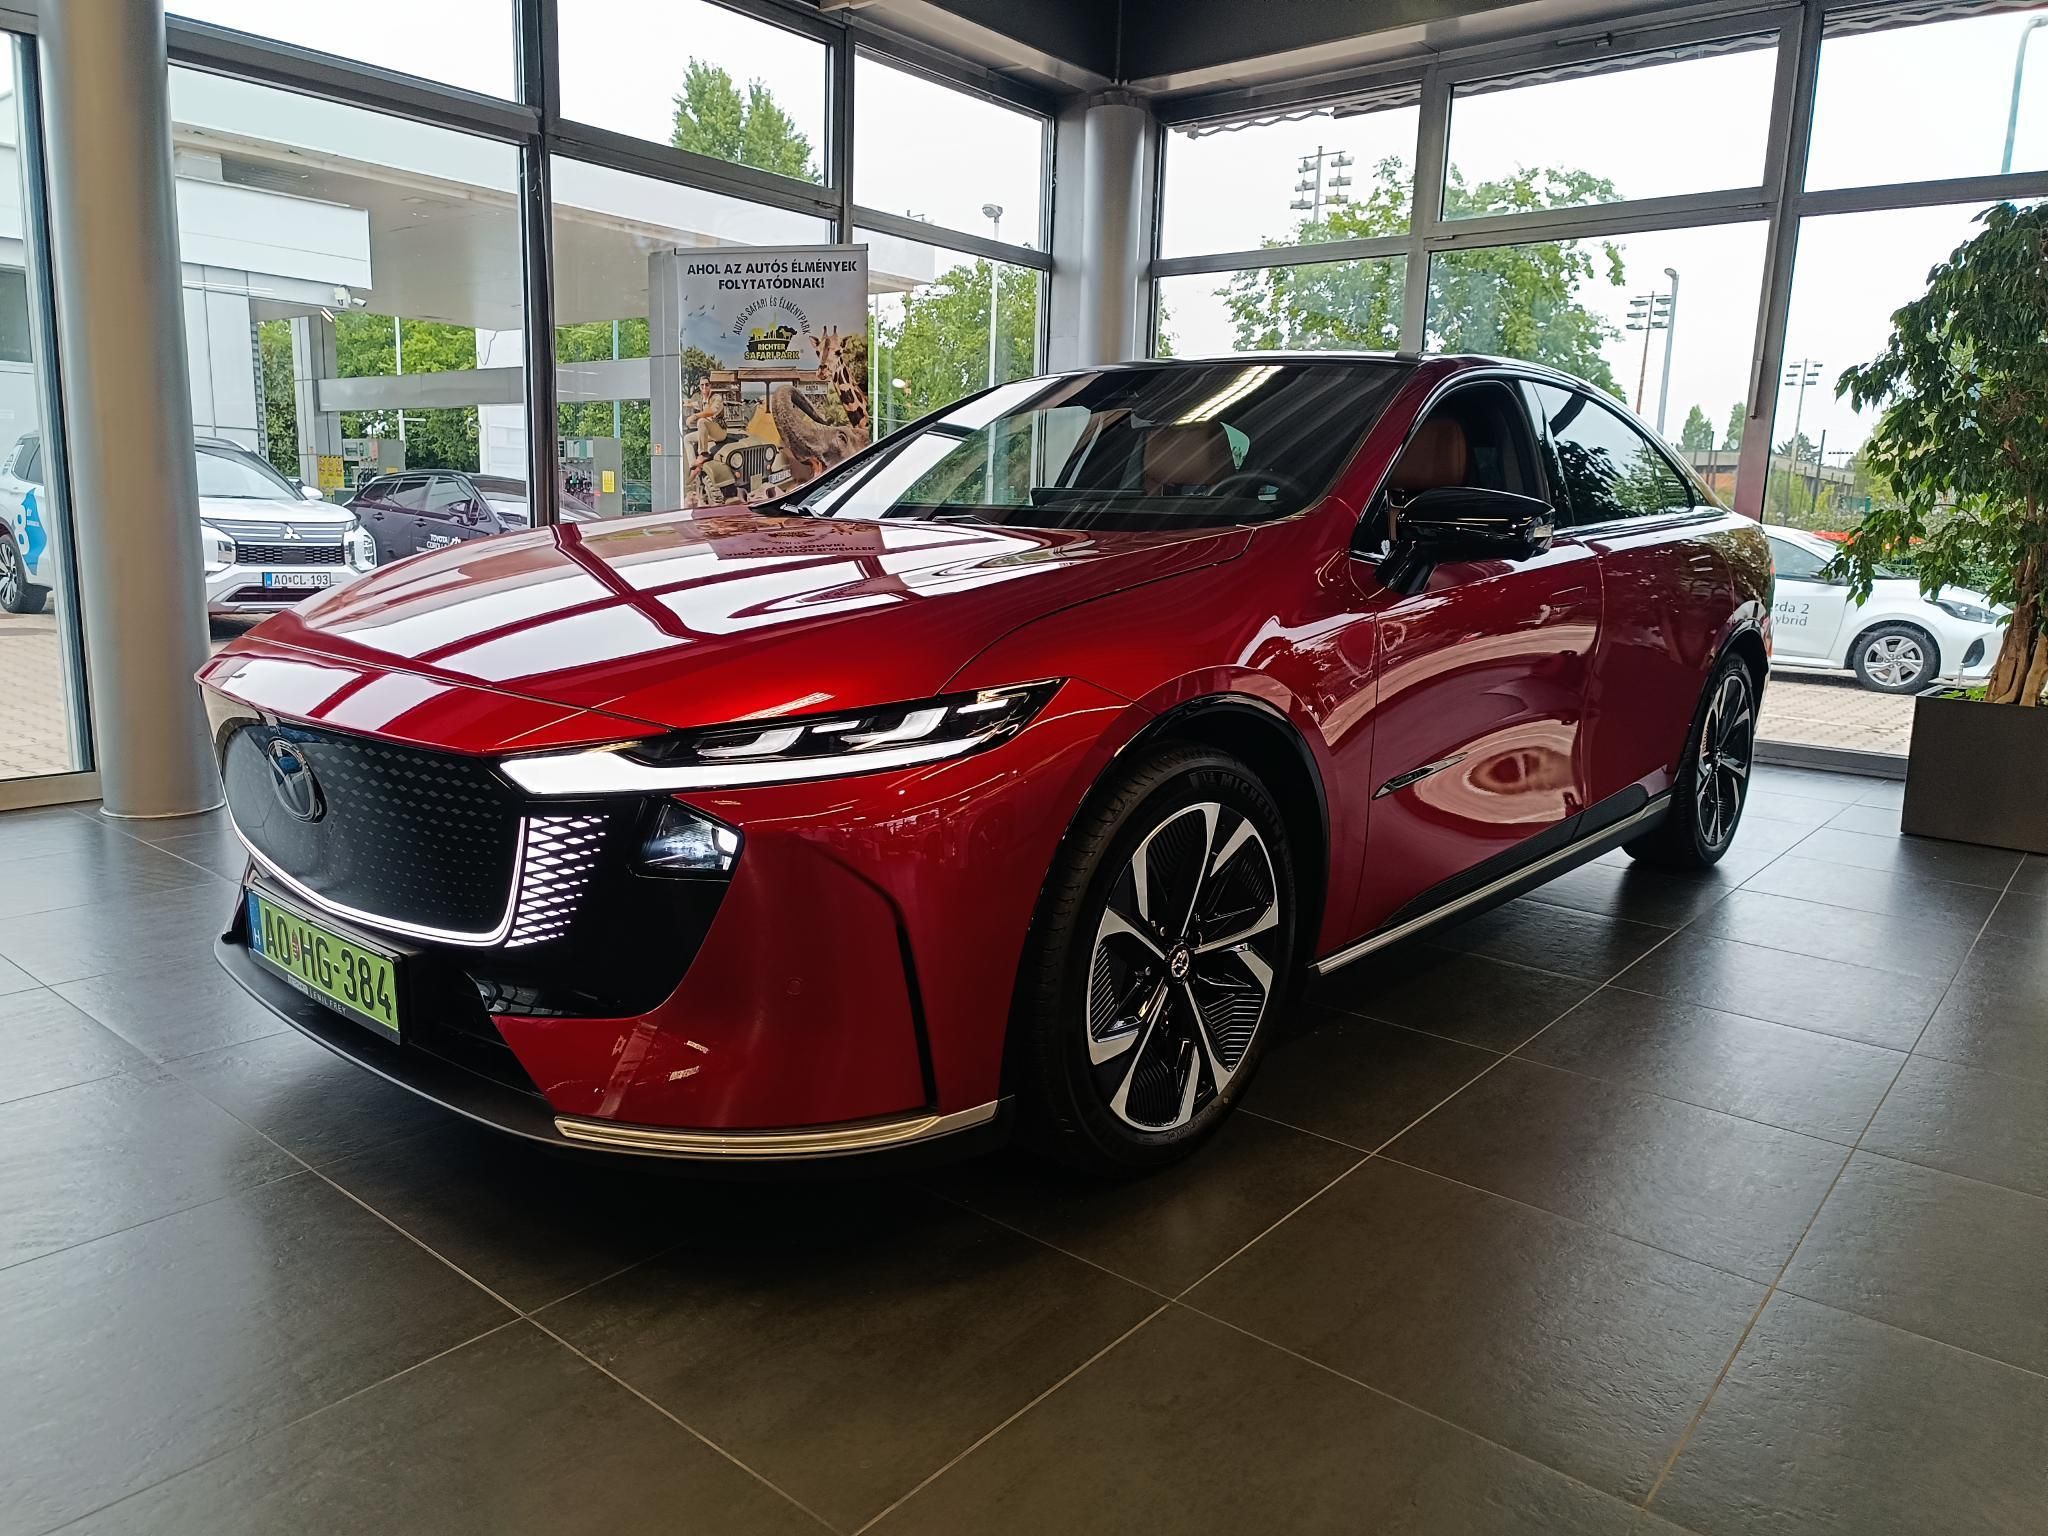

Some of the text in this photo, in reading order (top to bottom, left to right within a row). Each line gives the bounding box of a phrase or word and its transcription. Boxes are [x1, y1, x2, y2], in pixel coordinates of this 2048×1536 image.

[687, 258, 857, 275] AHOL AZ AUTÓS ÉLMÉNYEK
[719, 275, 825, 290] FOLYTATÓDNAK!
[732, 295, 812, 335] AUTÓS SAFARI ÉS ÉLMÉNYPARK
[757, 343, 786, 351] RICHTER
[744, 350, 800, 360] SAFARI PARK
[274, 574, 288, 585] AO
[1774, 601, 1810, 615] zda 2
[1775, 613, 1808, 626] ybrid
[1221, 773, 1283, 844] MICHELIN
[253, 906, 393, 1021] H AO HG-384
[329, 999, 348, 1015] FREY
